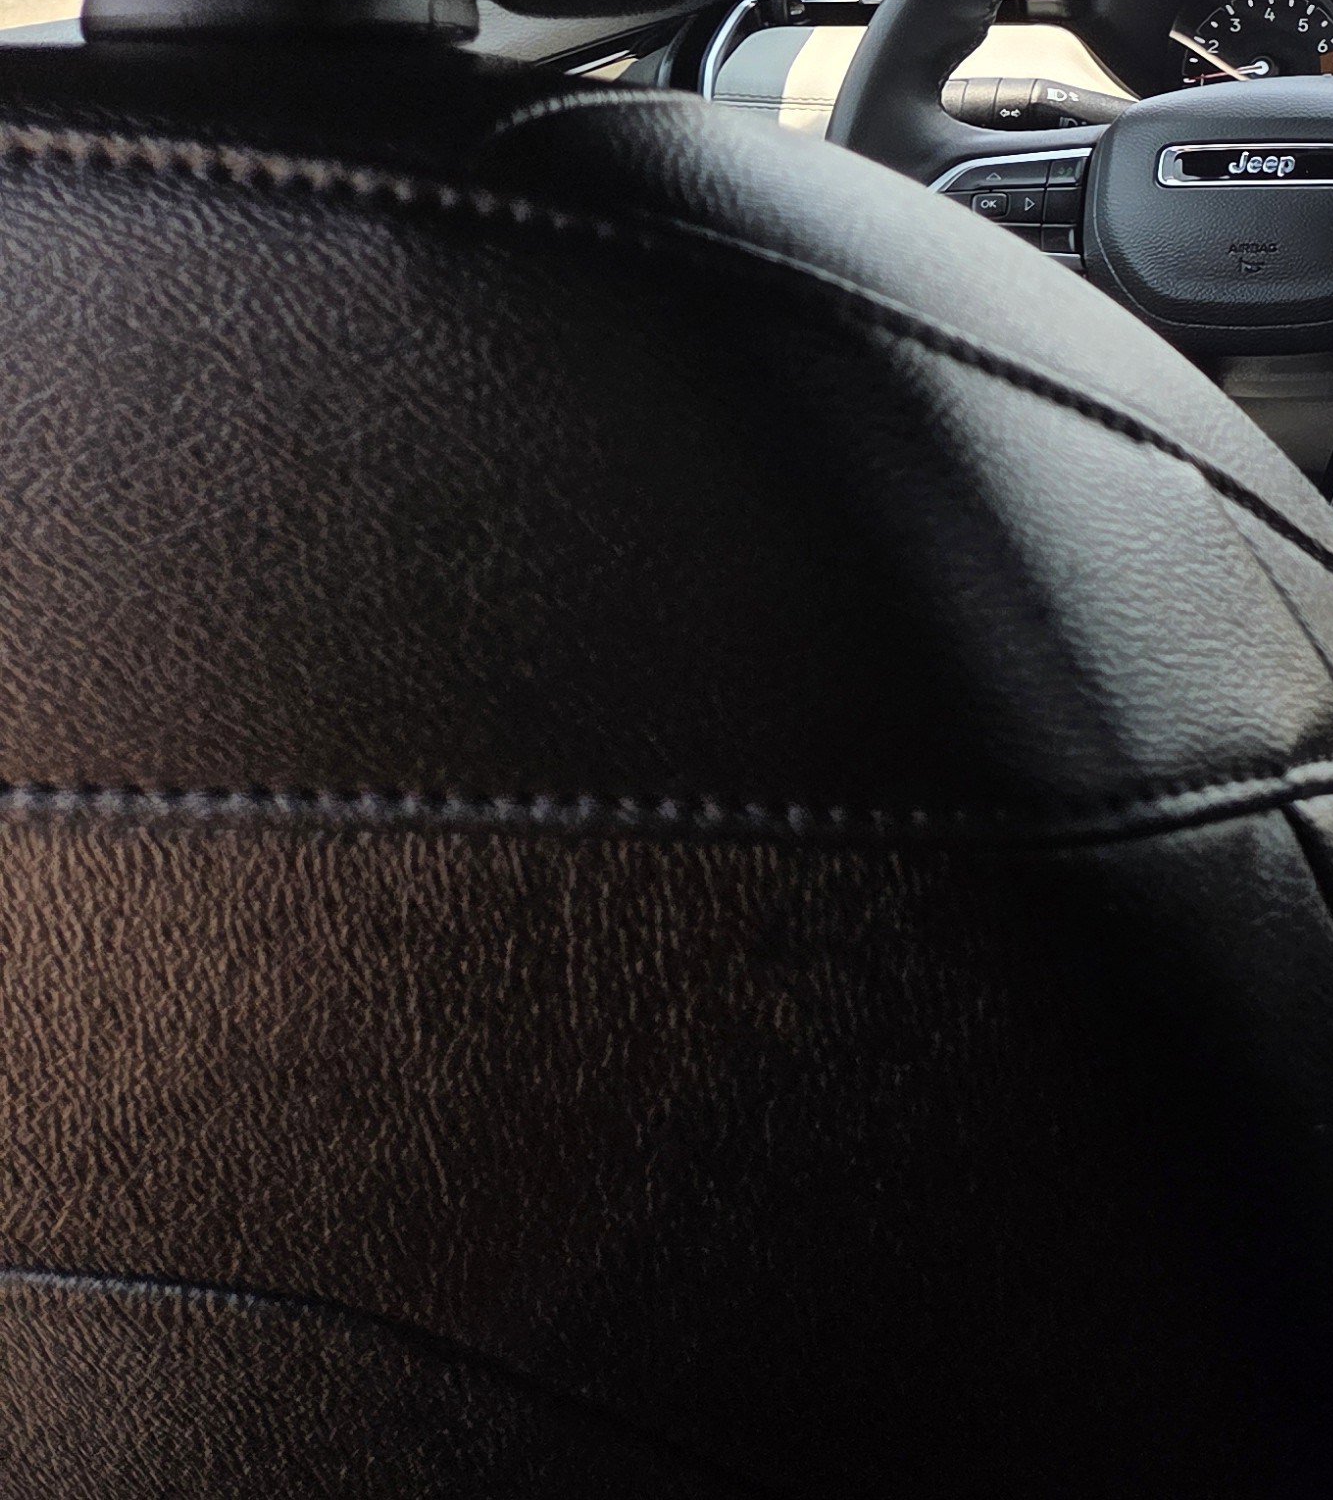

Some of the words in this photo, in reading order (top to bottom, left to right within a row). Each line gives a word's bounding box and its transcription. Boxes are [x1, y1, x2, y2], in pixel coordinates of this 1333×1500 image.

[1264, 7, 1275, 22] 4
[1230, 18, 1241, 32] 3
[1298, 18, 1309, 32] 5
[1206, 39, 1220, 54] 2
[1317, 38, 1328, 53] 6
[1228, 151, 1296, 177] Jeep
[981, 199, 997, 209] OK
[1228, 243, 1279, 254] AIRBAG
